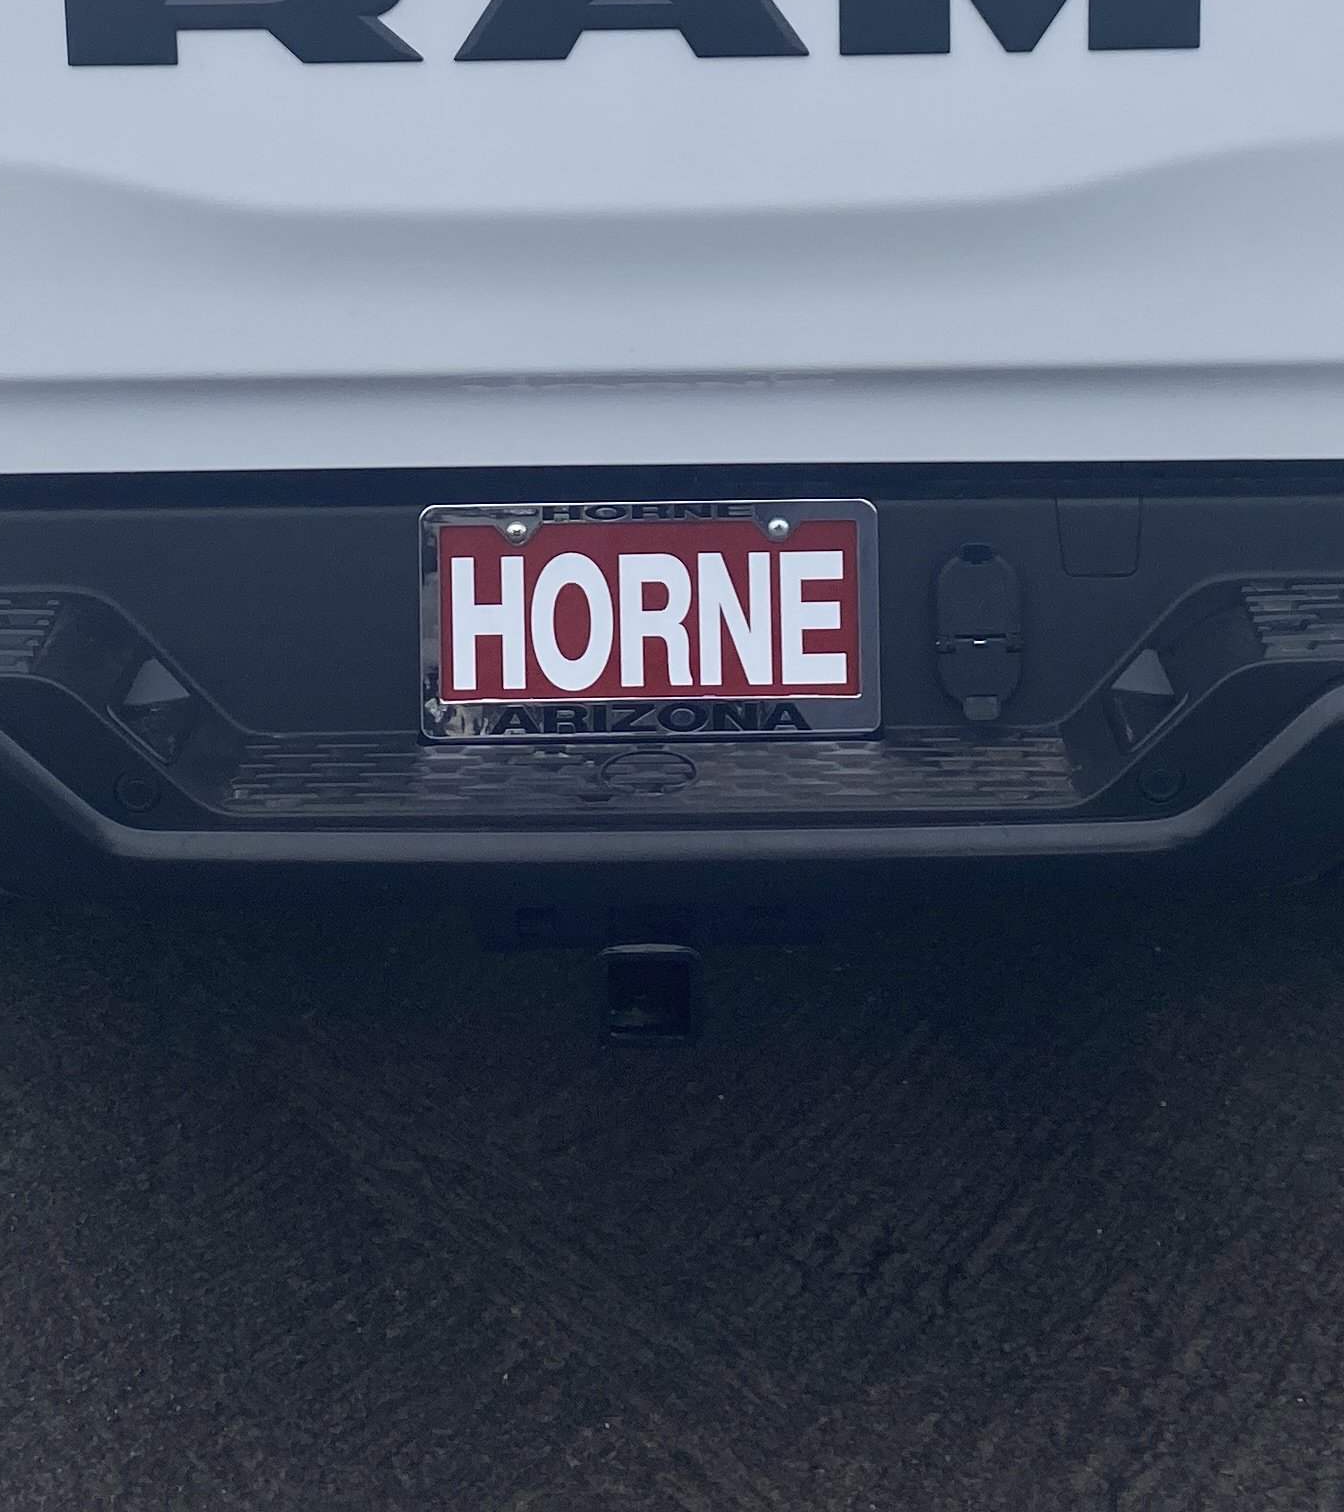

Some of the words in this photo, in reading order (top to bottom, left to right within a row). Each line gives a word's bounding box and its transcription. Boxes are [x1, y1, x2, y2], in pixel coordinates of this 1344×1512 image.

[542, 504, 755, 521] HORNE
[451, 550, 847, 691] HORNE
[491, 702, 811, 735] ARIZONA
